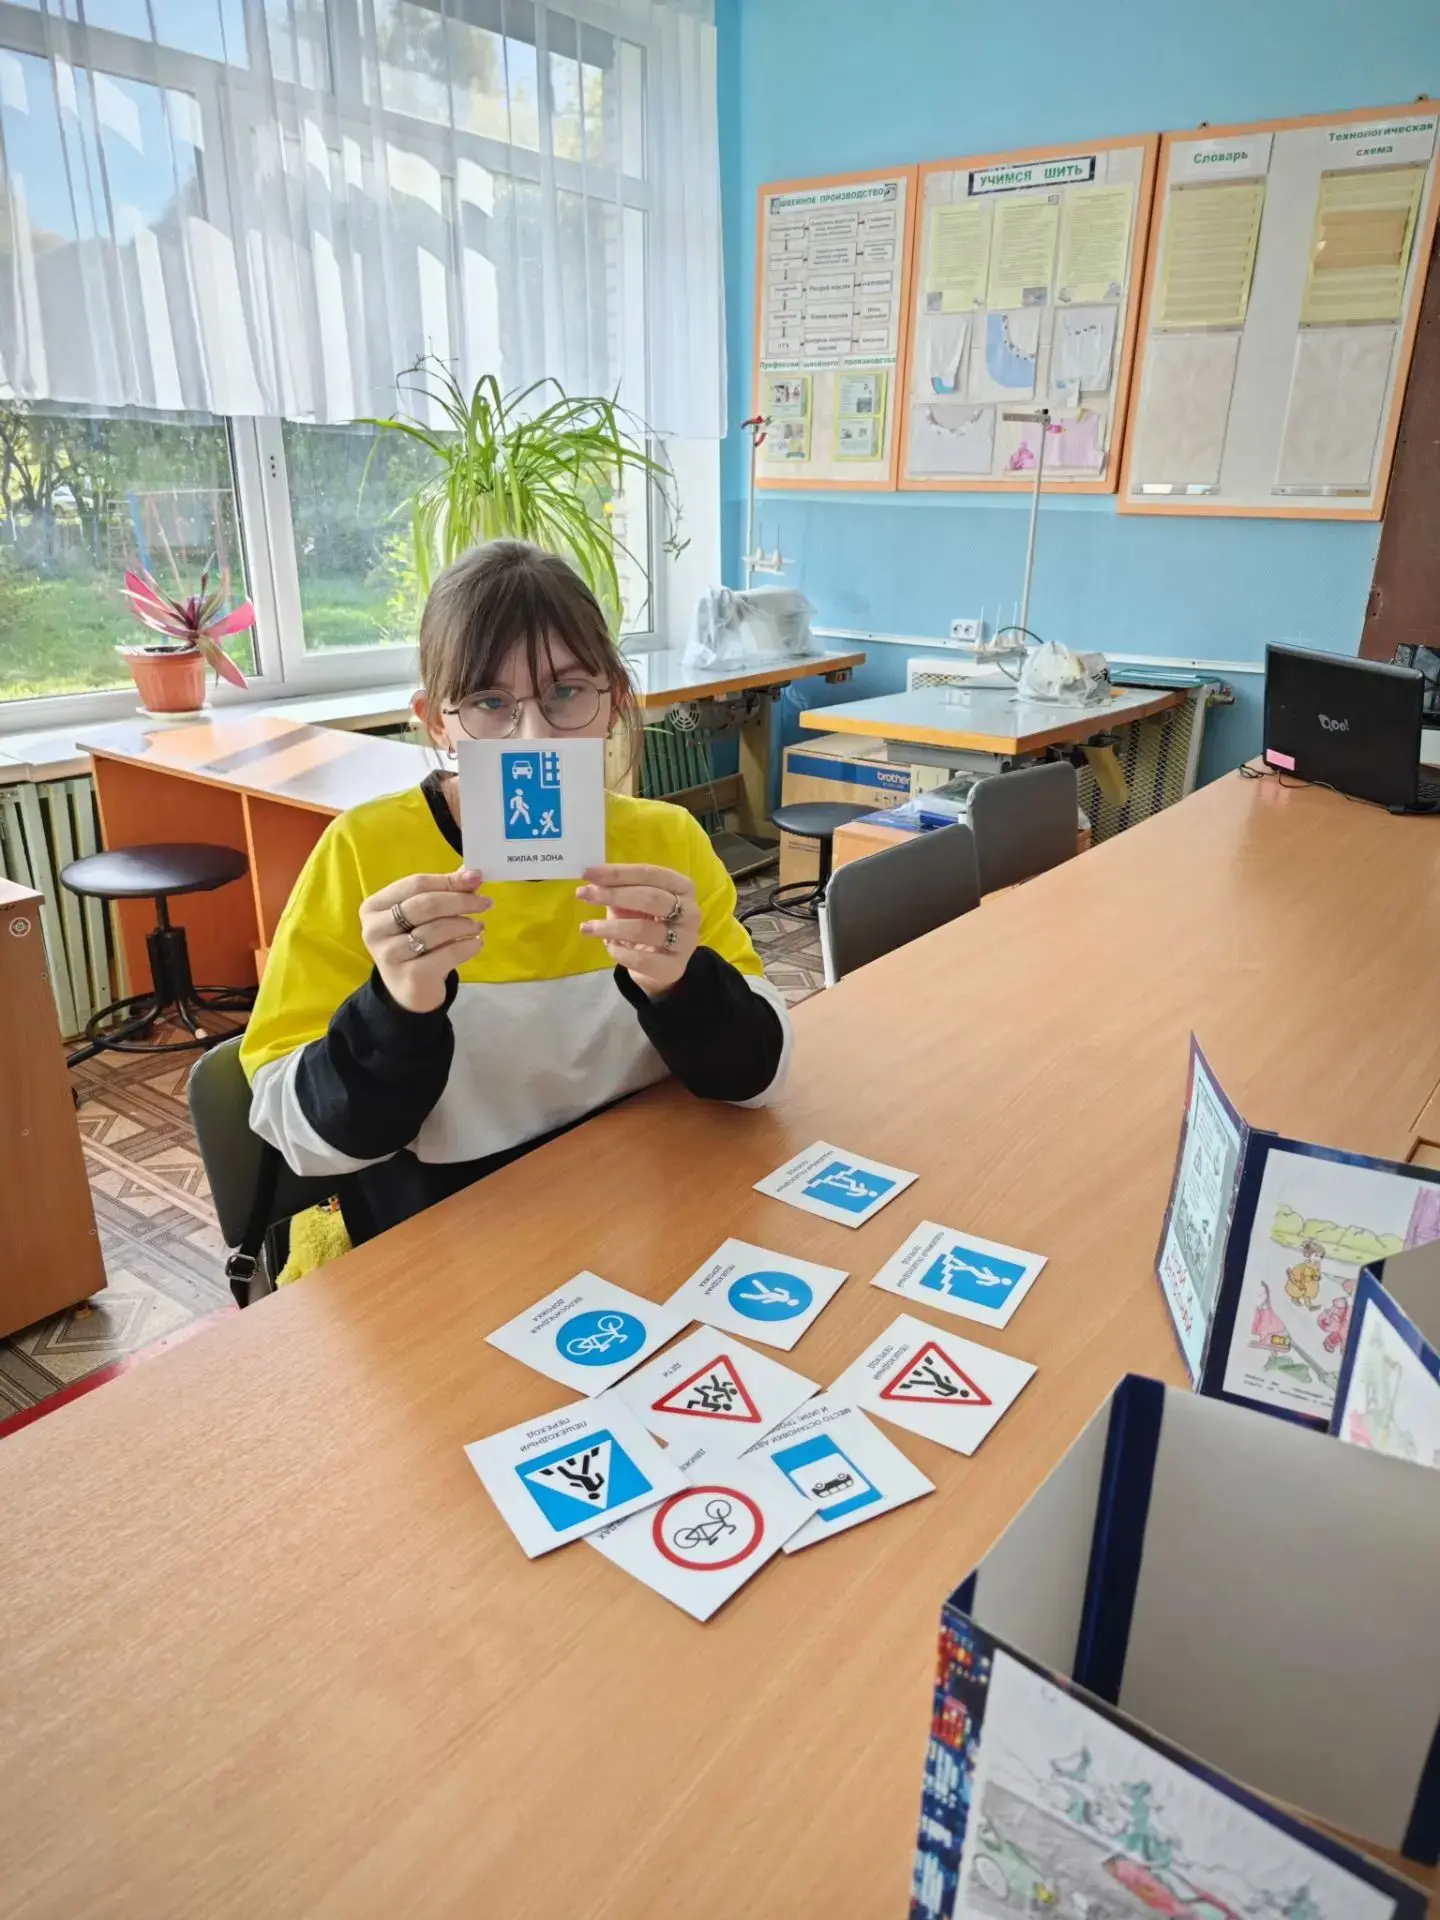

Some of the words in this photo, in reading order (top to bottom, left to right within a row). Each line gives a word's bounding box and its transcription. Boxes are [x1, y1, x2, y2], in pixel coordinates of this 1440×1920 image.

[1328, 123, 1433, 142] Технологическая
[1193, 151, 1249, 165] Словарь
[1356, 145, 1393, 157] схема
[980, 170, 1032, 187] УЧИМСЯ
[1044, 165, 1082, 179] ШИТЬ
[820, 188, 884, 203] ПРОИЗВОДСТВО
[877, 769, 910, 784] brother
[506, 855, 539, 863] ЖИЛАЯ
[540, 854, 564, 862] ЗОНА
[532, 1298, 564, 1321] ДОРОЖКА
[663, 1362, 682, 1378] ДЕТИ
[822, 1407, 852, 1422] МЕСТО
[520, 1420, 588, 1452] ПЕШЕХОДНЫЙ
[526, 1417, 571, 1439] ПЕРЕХОД
[772, 1420, 822, 1443] ОСТАНОВКИ
